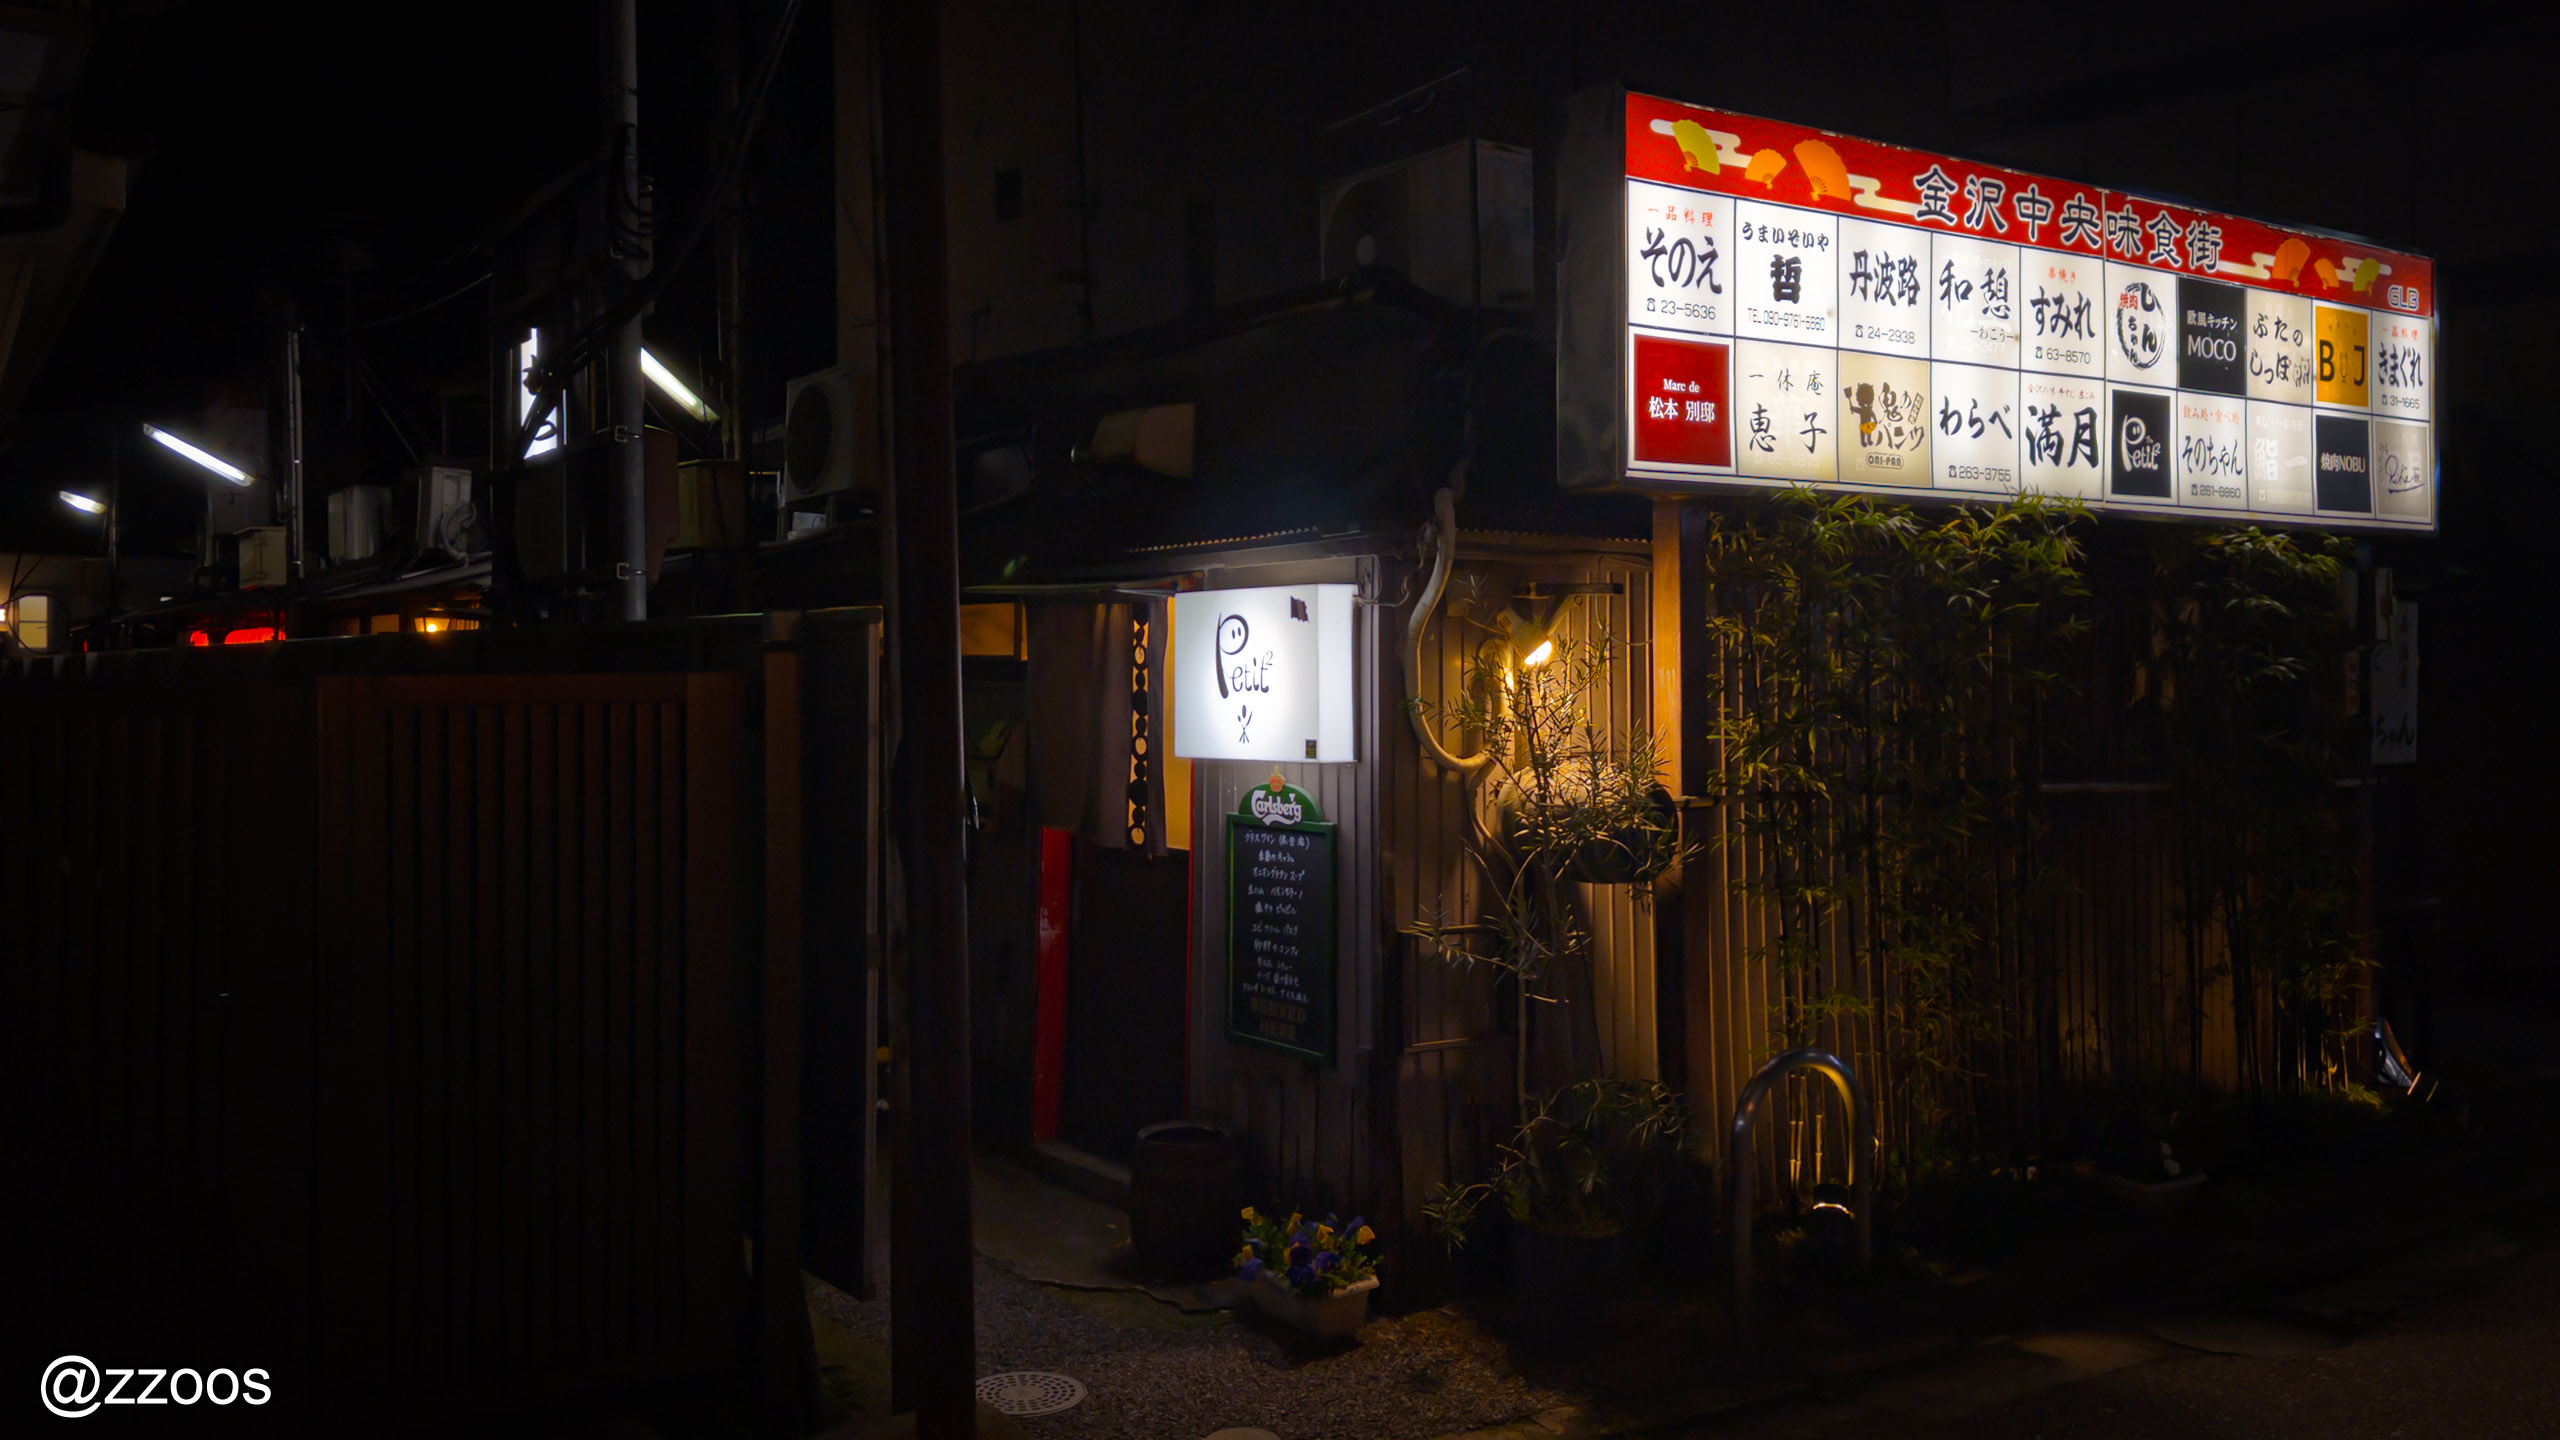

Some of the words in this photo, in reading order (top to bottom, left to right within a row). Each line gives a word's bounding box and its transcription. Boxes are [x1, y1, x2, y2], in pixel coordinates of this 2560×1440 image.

[1647, 205, 1714, 228] 一品料理
[1913, 163, 2223, 273] 金沢中央味食街
[1640, 226, 1723, 295] そのえ
[1770, 253, 1803, 304] 哲
[1849, 249, 1921, 307] 丹波路
[1938, 259, 2012, 320] 和憩
[1660, 299, 1717, 319] 23-5636
[1747, 307, 1762, 324] TEL
[2030, 284, 2096, 341] すみれ
[2186, 309, 2238, 331] 欧風キッチン
[1867, 325, 1916, 345] 24-2938
[2253, 313, 2304, 347] ぶたの
[2046, 348, 2091, 365] 63-8570
[2187, 334, 2237, 362] MOCO
[2318, 339, 2335, 381] B
[2353, 345, 2365, 386] J
[1748, 368, 1824, 396] 一休庵
[2250, 348, 2292, 385] しっぽ
[2378, 342, 2424, 389] きまぐれ
[1662, 378, 1687, 393] Marc
[1688, 381, 1700, 393] de
[1648, 395, 1679, 421] 松本
[1685, 400, 1716, 424] 別邸
[1939, 395, 2013, 440] わらべ
[1749, 402, 1828, 455] 恵子
[1875, 422, 1925, 452] パンツ
[2024, 404, 2100, 468] 満月
[2182, 434, 2244, 477] そのちゃん
[2320, 452, 2366, 474] 焼肉NOBU
[1958, 465, 2012, 482] 263-3755
[1251, 789, 1302, 822] Carlsberg
